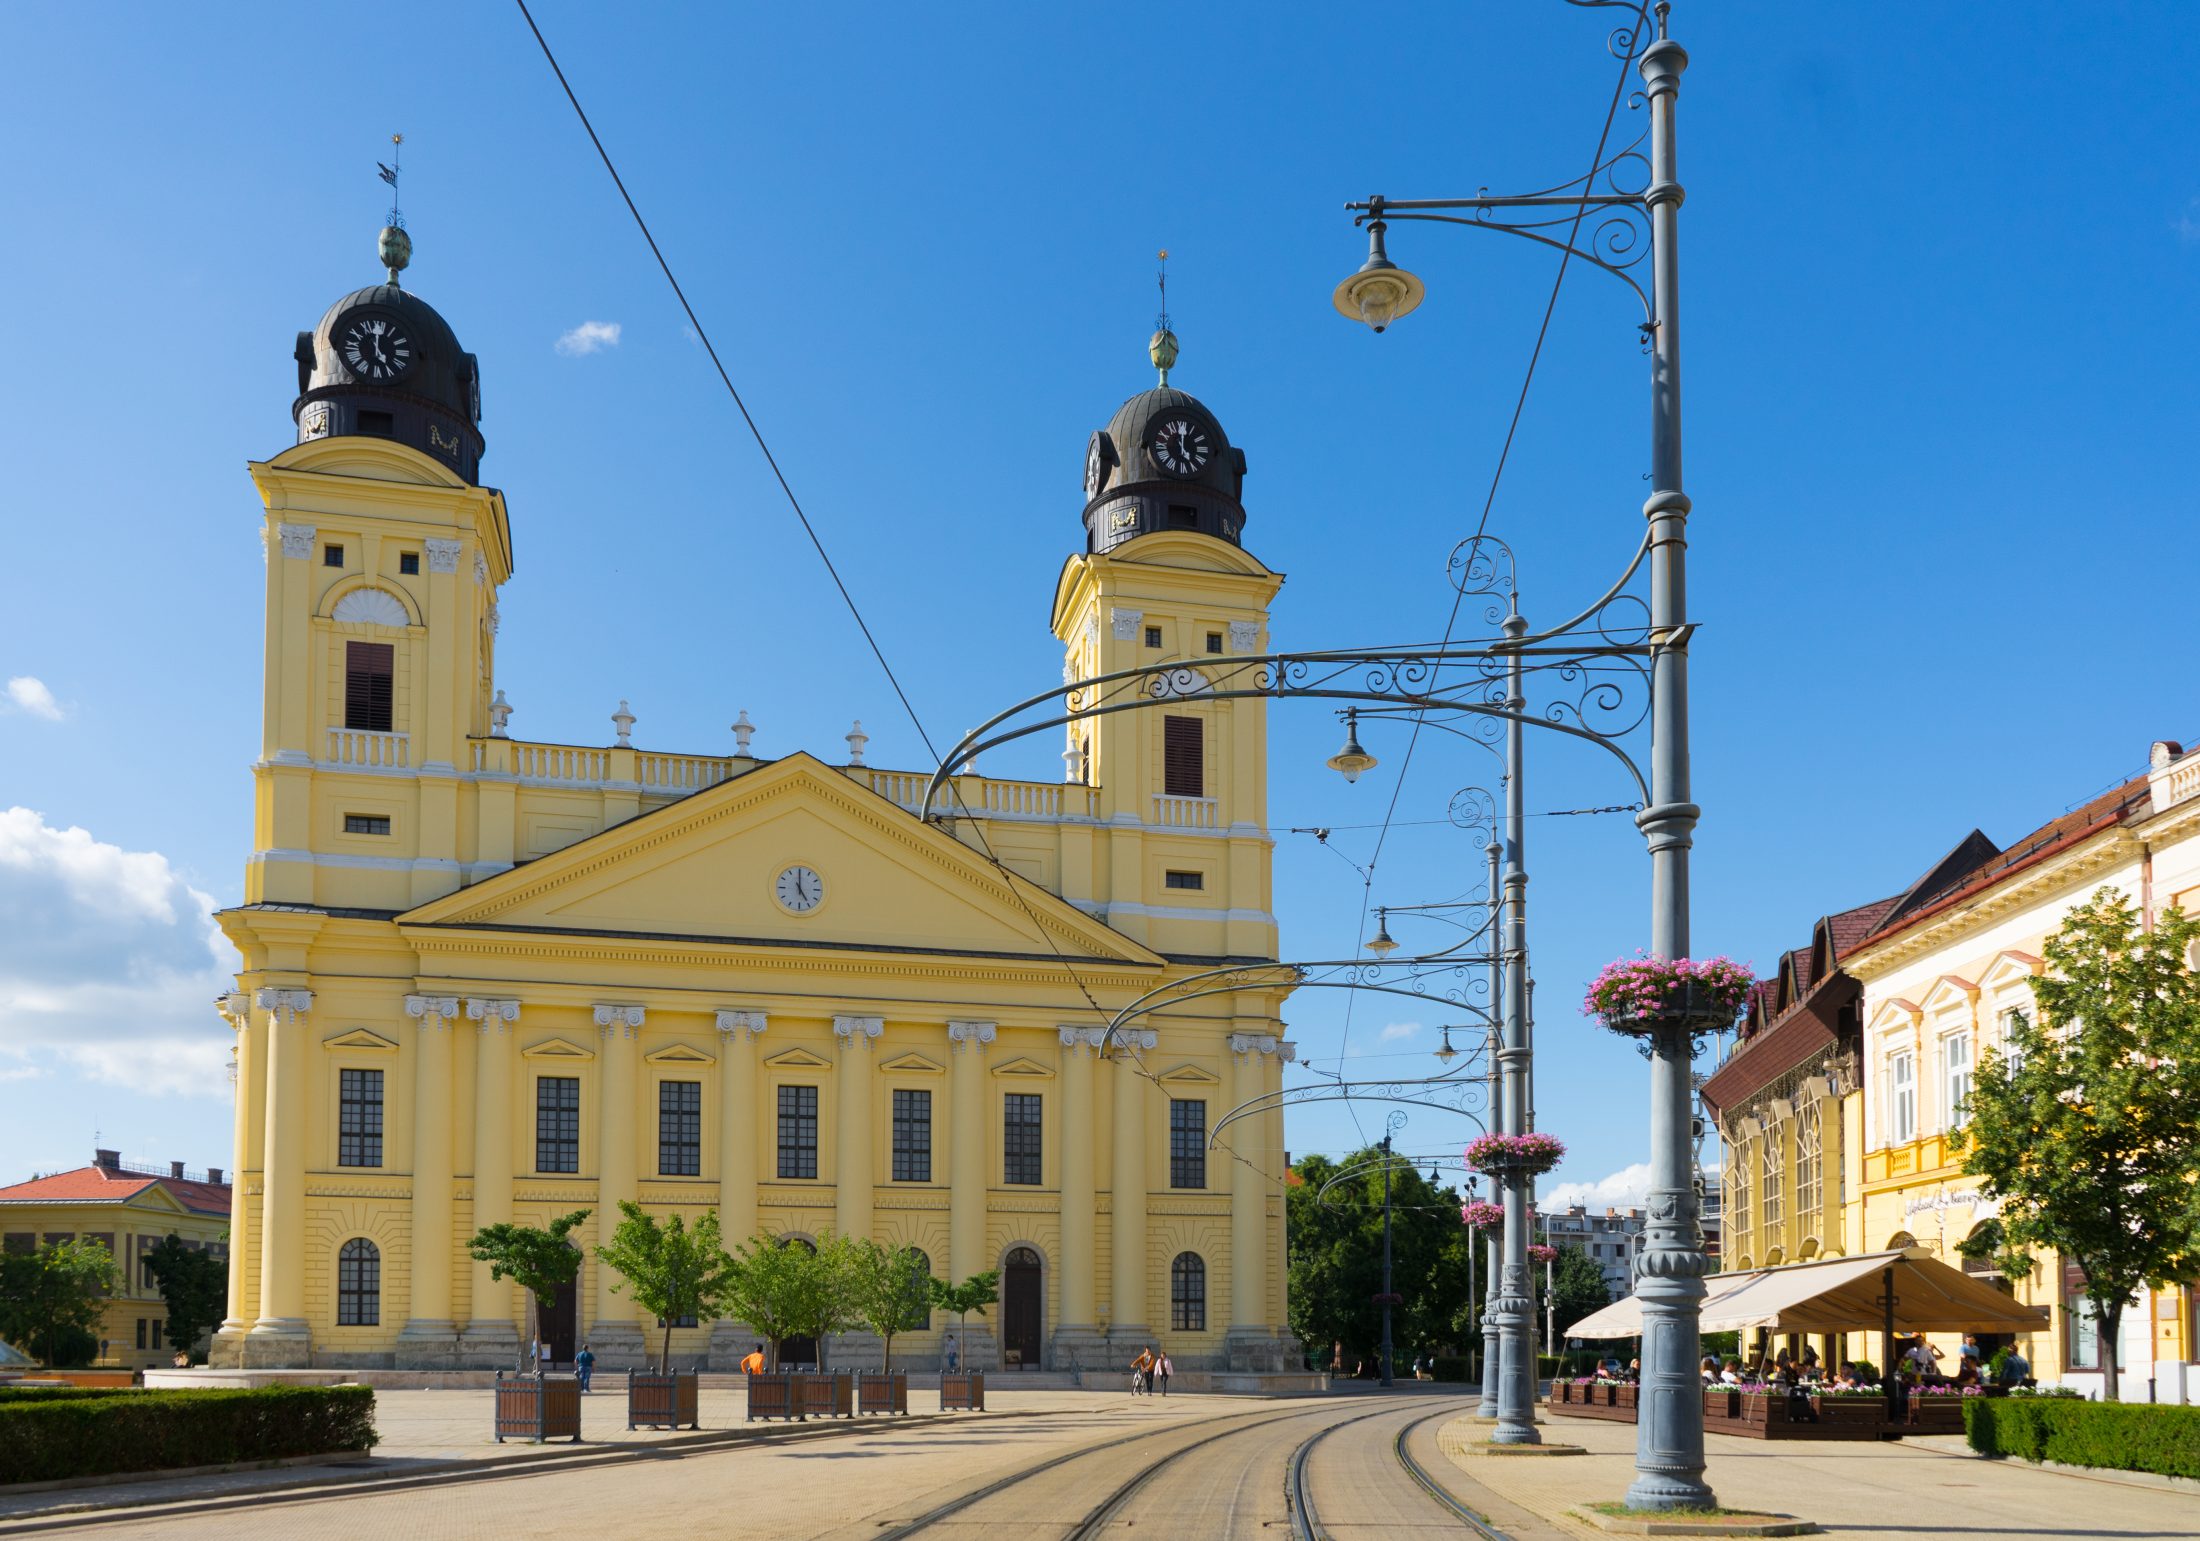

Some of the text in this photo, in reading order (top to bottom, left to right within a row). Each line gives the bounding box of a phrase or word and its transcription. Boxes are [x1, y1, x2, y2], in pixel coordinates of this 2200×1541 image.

[360, 320, 372, 335] XI
[349, 328, 363, 341] X
[393, 338, 407, 346] II
[374, 365, 382, 378] VI
[385, 365, 394, 377] V
[1166, 421, 1177, 435] XI
[1158, 430, 1169, 440] X
[1194, 435, 1205, 443] II
[1180, 462, 1187, 474] VI
[1190, 462, 1197, 472] V
